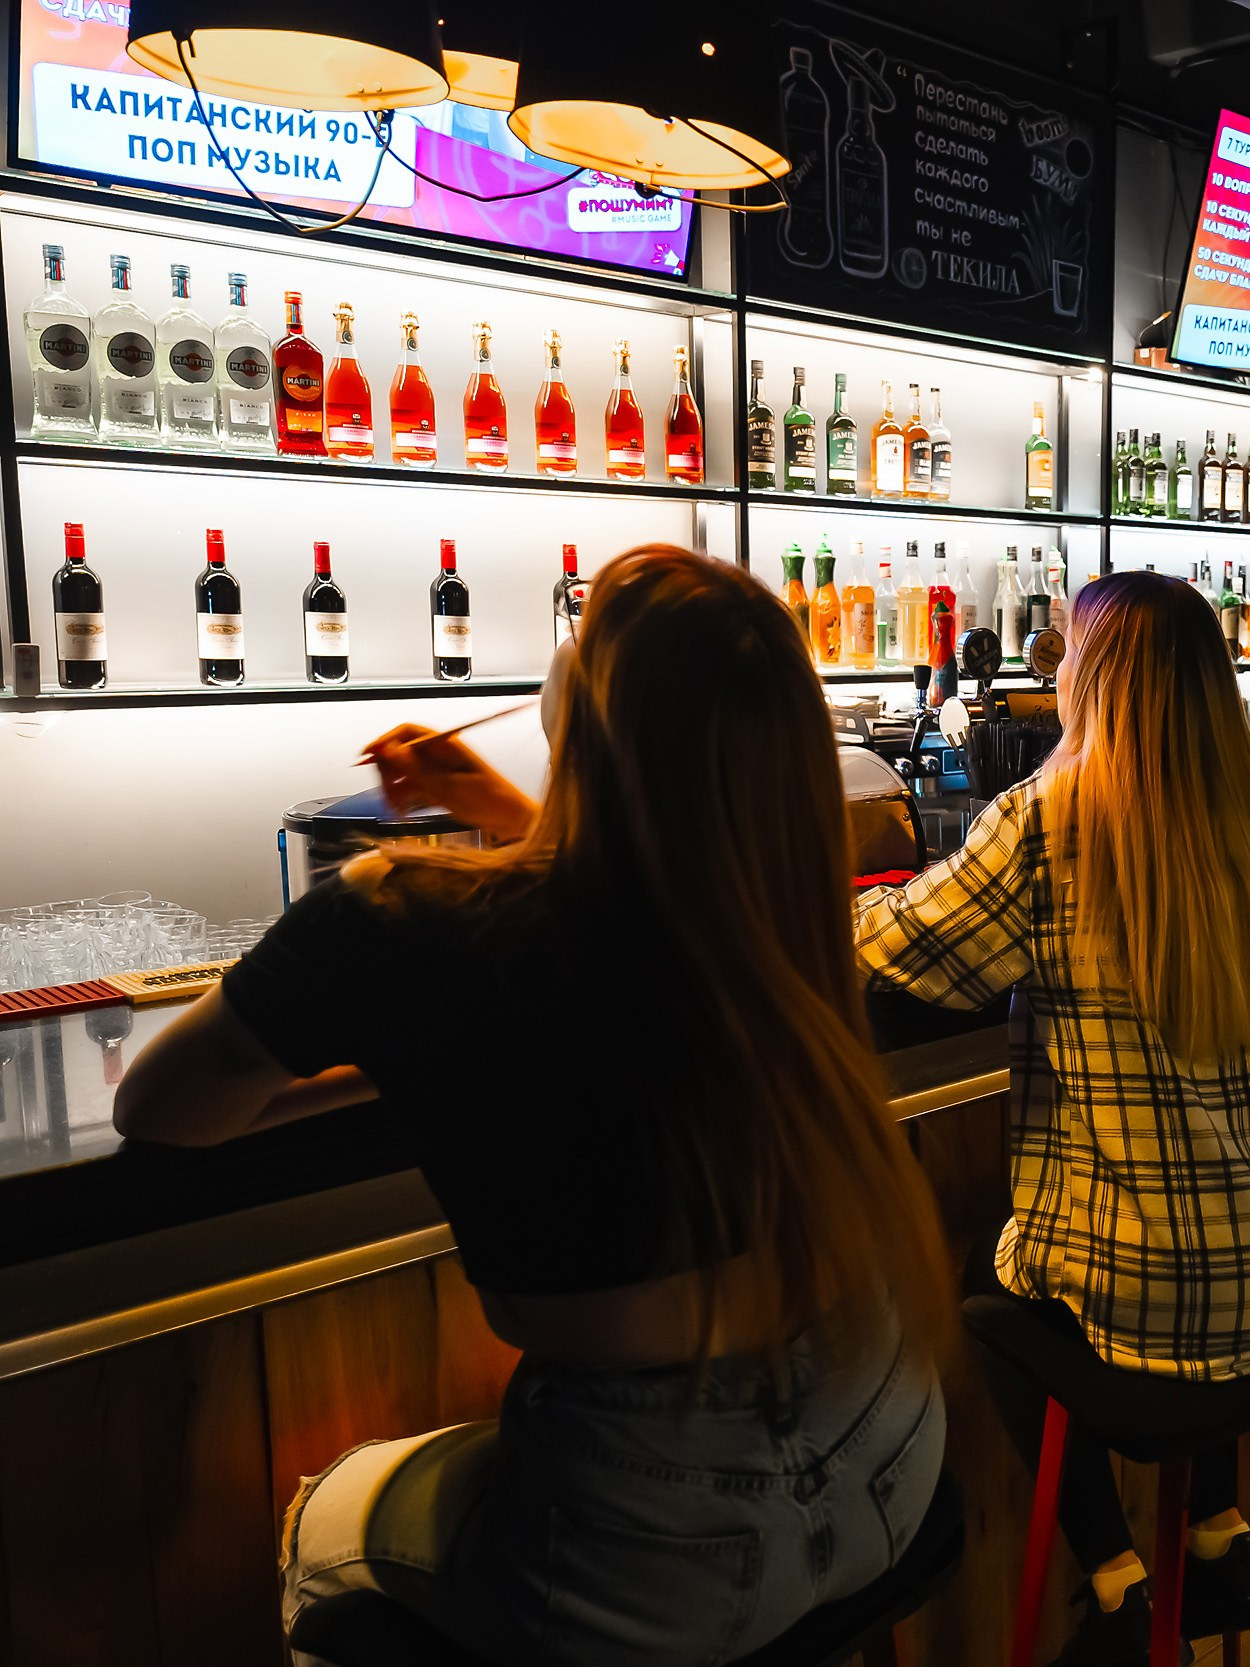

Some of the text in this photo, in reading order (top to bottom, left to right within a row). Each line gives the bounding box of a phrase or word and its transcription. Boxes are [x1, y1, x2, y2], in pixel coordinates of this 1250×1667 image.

[40, 0, 131, 27] СДАЧ
[914, 73, 1009, 125] Перестань
[70, 82, 316, 139] КАПИТАНСКИЙ
[916, 105, 997, 143] пытаться
[915, 130, 989, 166] сделать
[1226, 137, 1233, 150] 7
[128, 134, 342, 182] ПОП МУЗЫКА
[915, 158, 989, 193] каждого
[1211, 172, 1224, 186] 10
[1206, 200, 1218, 214] 10
[611, 214, 672, 224] #MUSIC GAME
[916, 218, 973, 247] ты не
[1202, 218, 1250, 243] КАЖДЫЙ
[1197, 246, 1212, 261] 50
[931, 249, 1021, 296] ТЕКИЛА
[1193, 264, 1230, 284] СДАЧУ
[45, 341, 86, 353] MARTINI
[112, 349, 152, 361] MARTINI
[1208, 341, 1233, 355] ПОП
[174, 356, 212, 368] MARTINI
[231, 363, 268, 374] MARTINI
[286, 377, 320, 387] MARTINI
